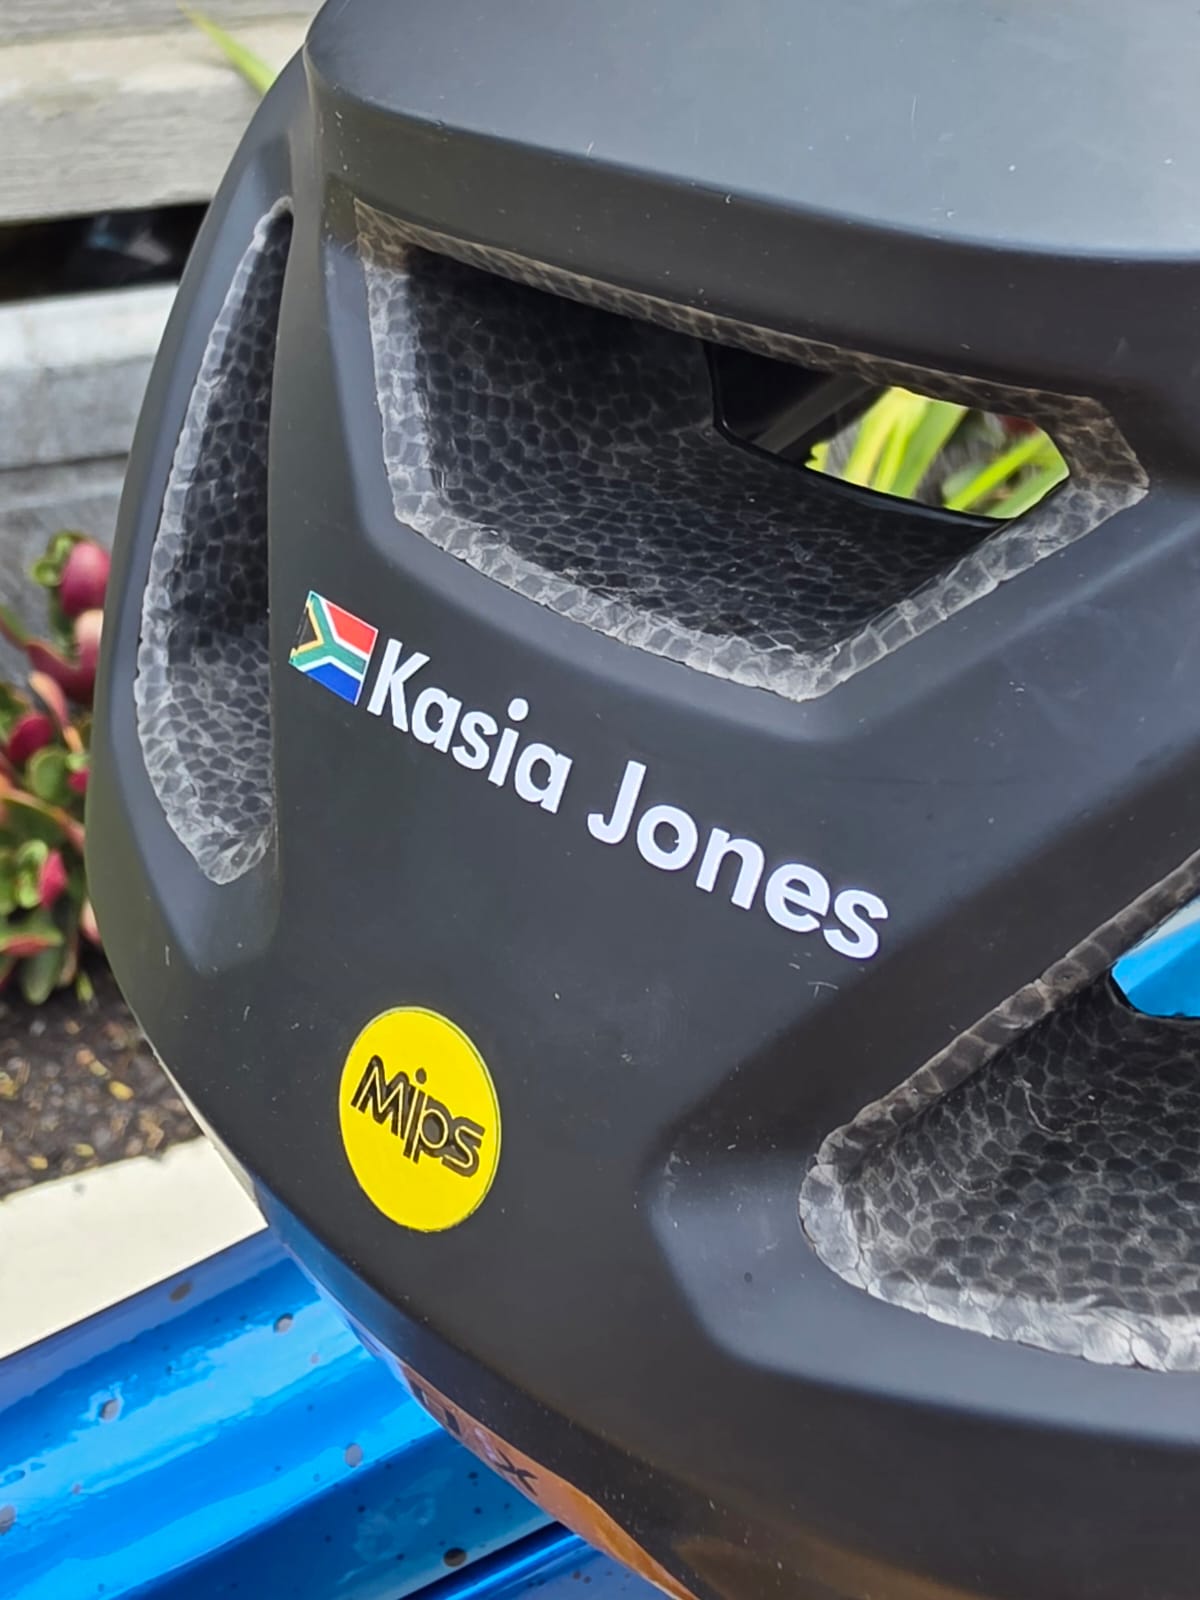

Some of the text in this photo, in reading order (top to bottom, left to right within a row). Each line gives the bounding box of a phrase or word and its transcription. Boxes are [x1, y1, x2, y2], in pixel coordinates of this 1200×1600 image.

[366, 638, 889, 959] Kasia Jones
[350, 1054, 486, 1178] Mips
